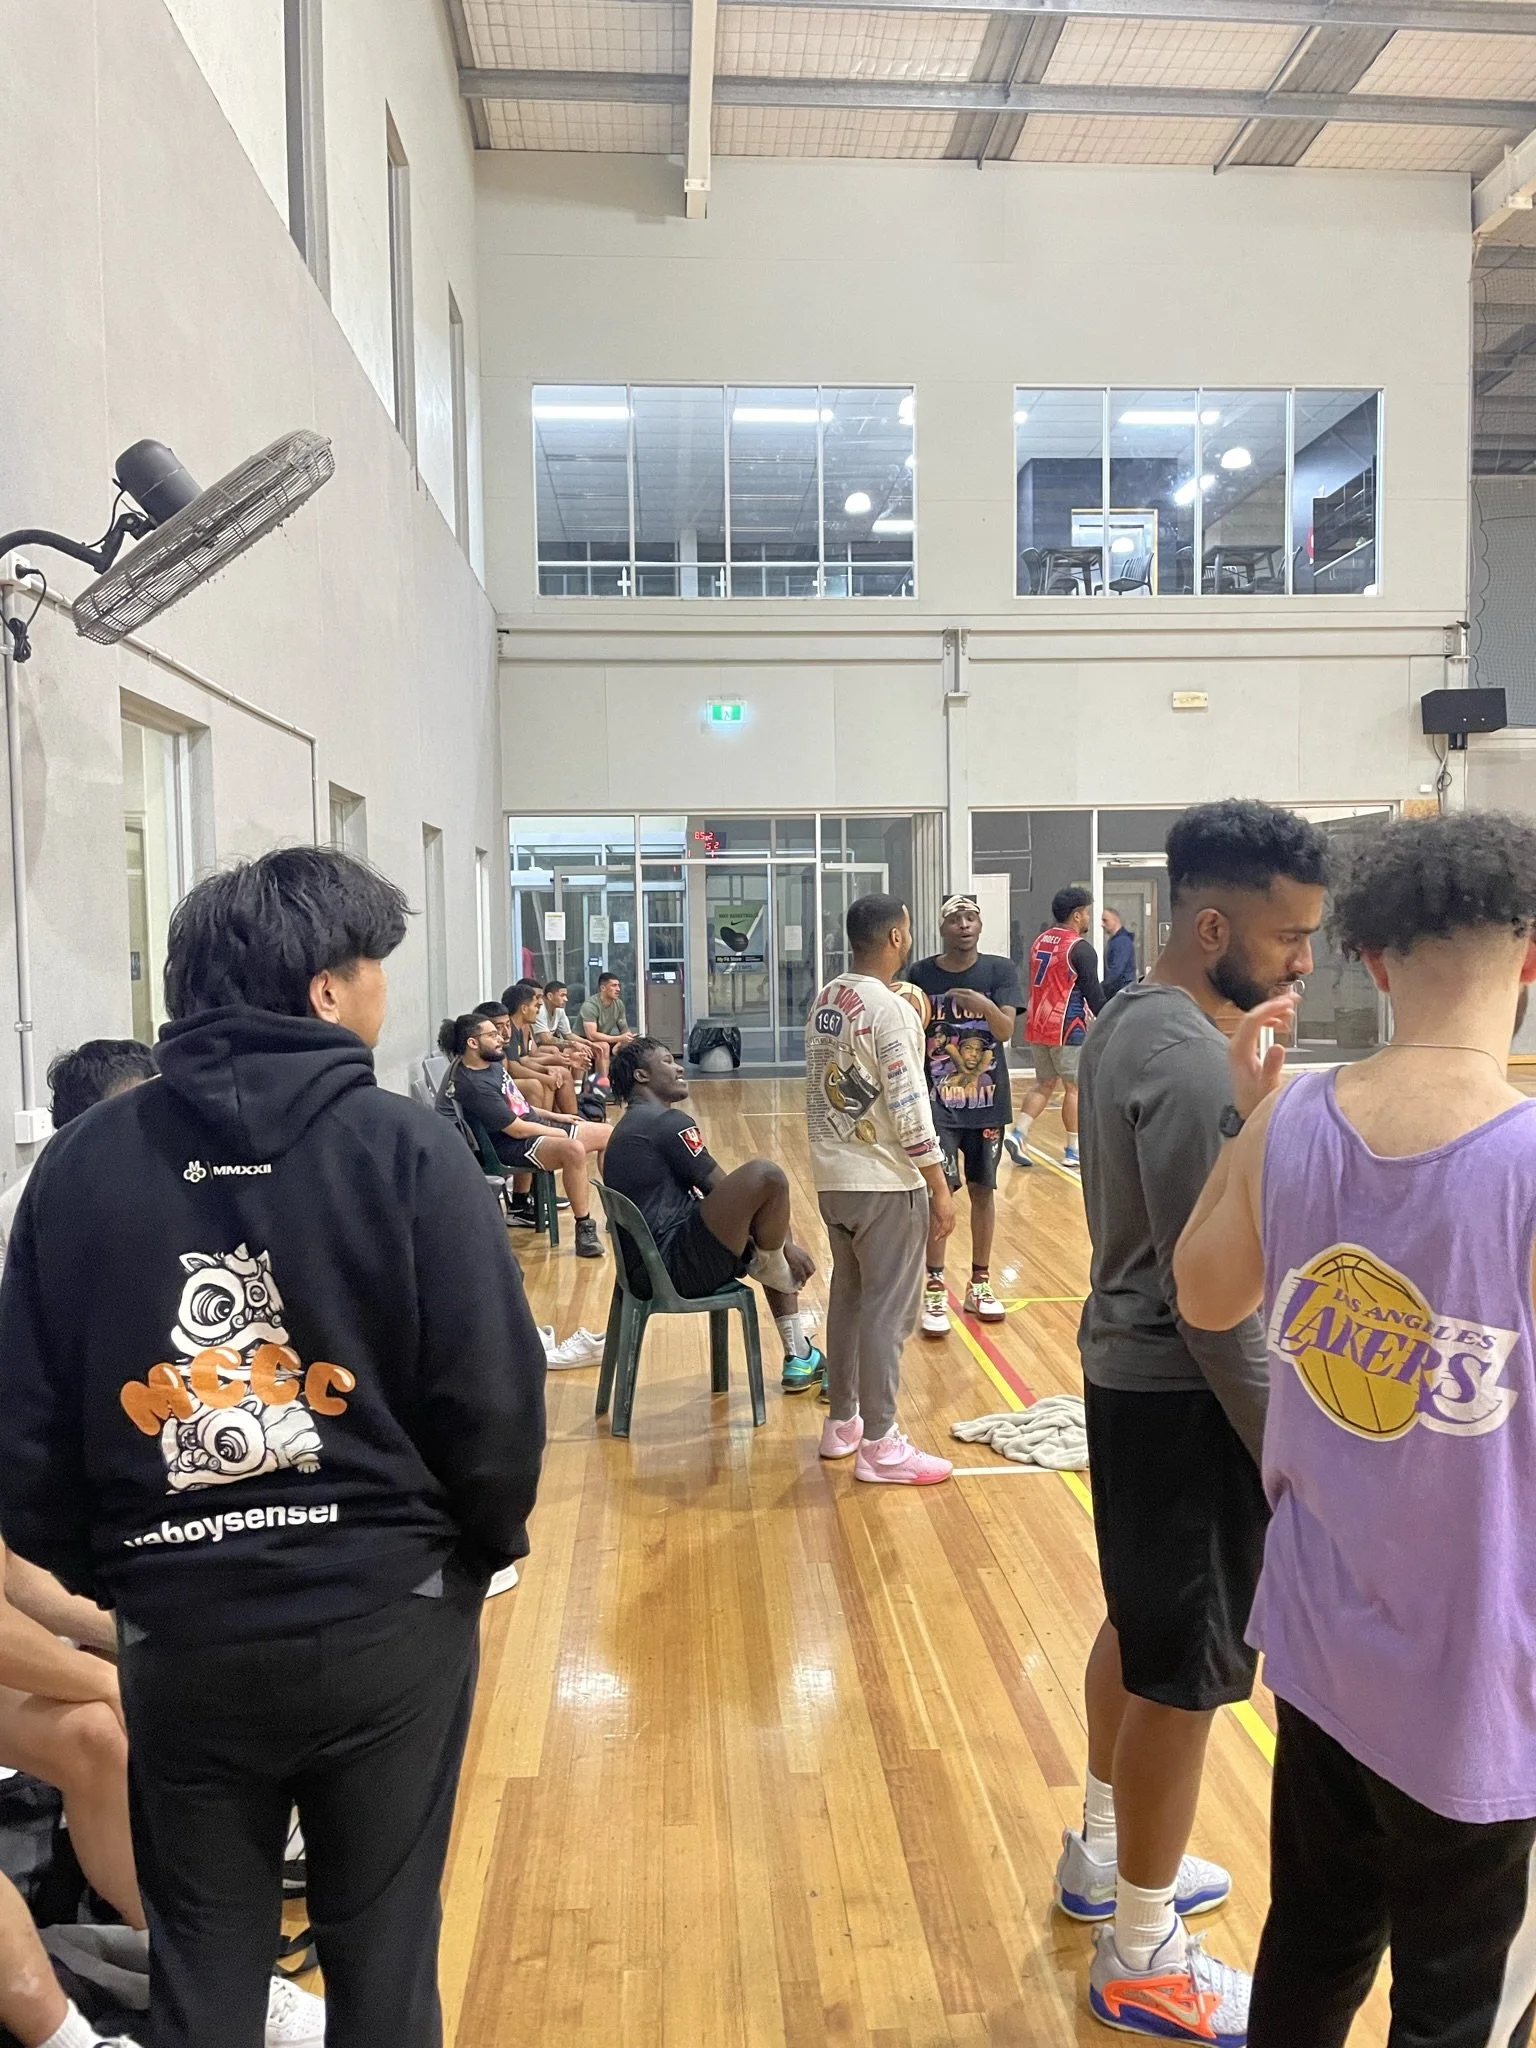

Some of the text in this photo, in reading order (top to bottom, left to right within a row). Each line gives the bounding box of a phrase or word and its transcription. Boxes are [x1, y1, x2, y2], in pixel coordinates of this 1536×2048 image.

[1033, 950, 1053, 987] 7
[818, 1013, 841, 1031] 1967
[213, 1164, 272, 1175] MMXXII
[1273, 1277, 1503, 1425] LAKERS
[120, 1343, 356, 1436] MCCC
